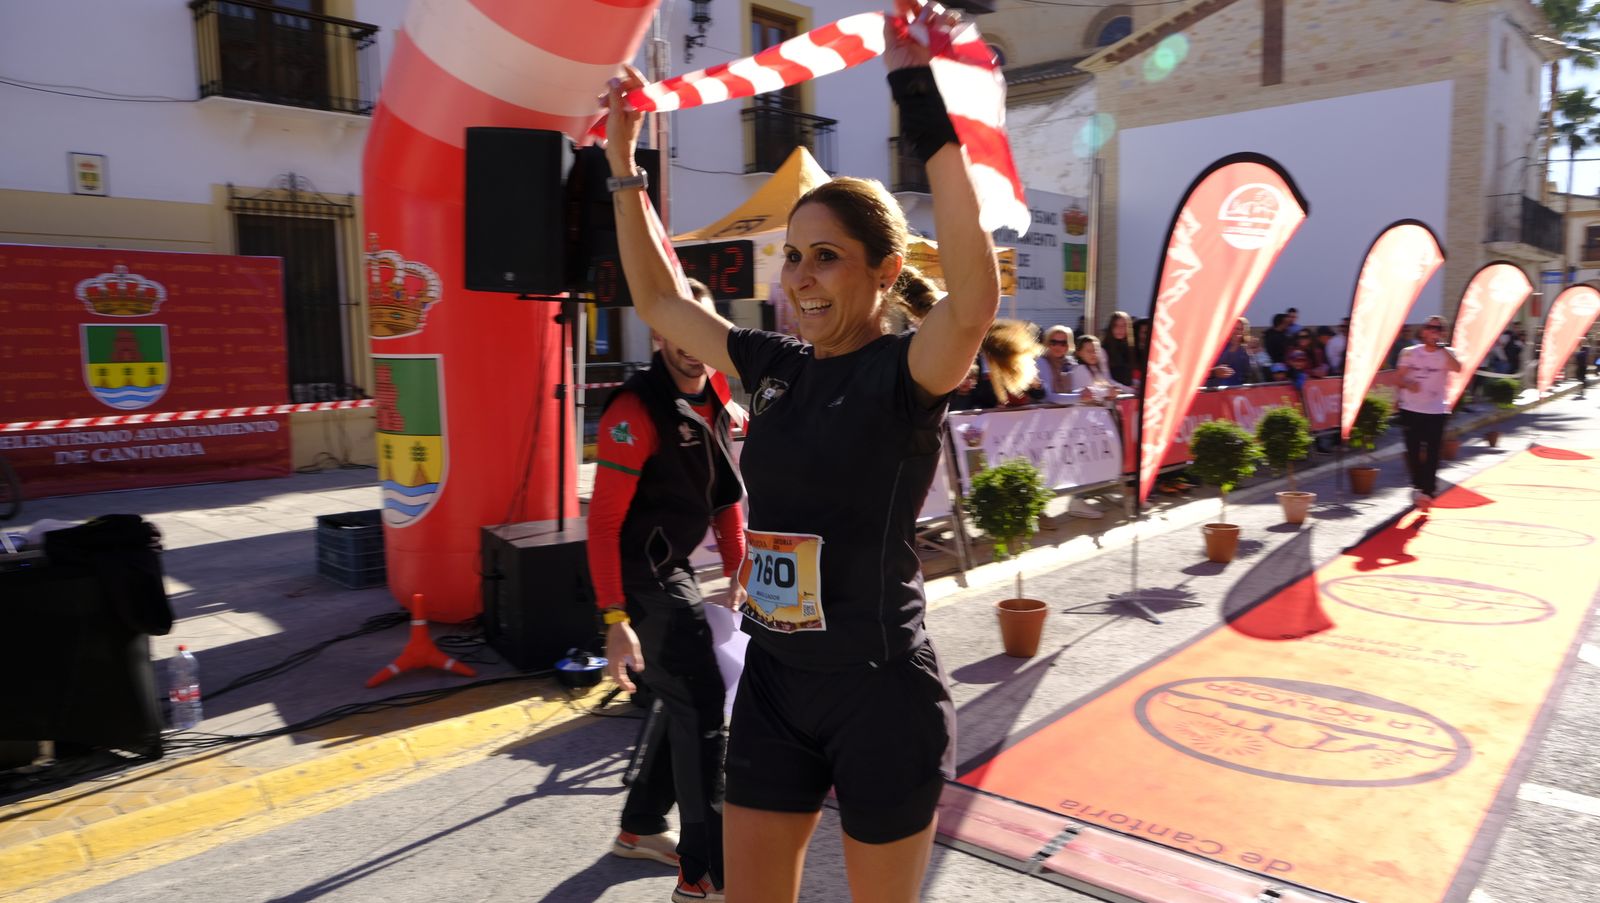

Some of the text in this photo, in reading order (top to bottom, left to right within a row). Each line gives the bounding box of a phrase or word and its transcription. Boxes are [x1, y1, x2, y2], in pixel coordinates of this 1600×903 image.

[710, 247, 745, 293] 12
[133, 420, 280, 441] AYUNTAMIENTO
[54, 442, 206, 465] DE CANTORIA
[1059, 798, 1294, 873] de Cantoria
